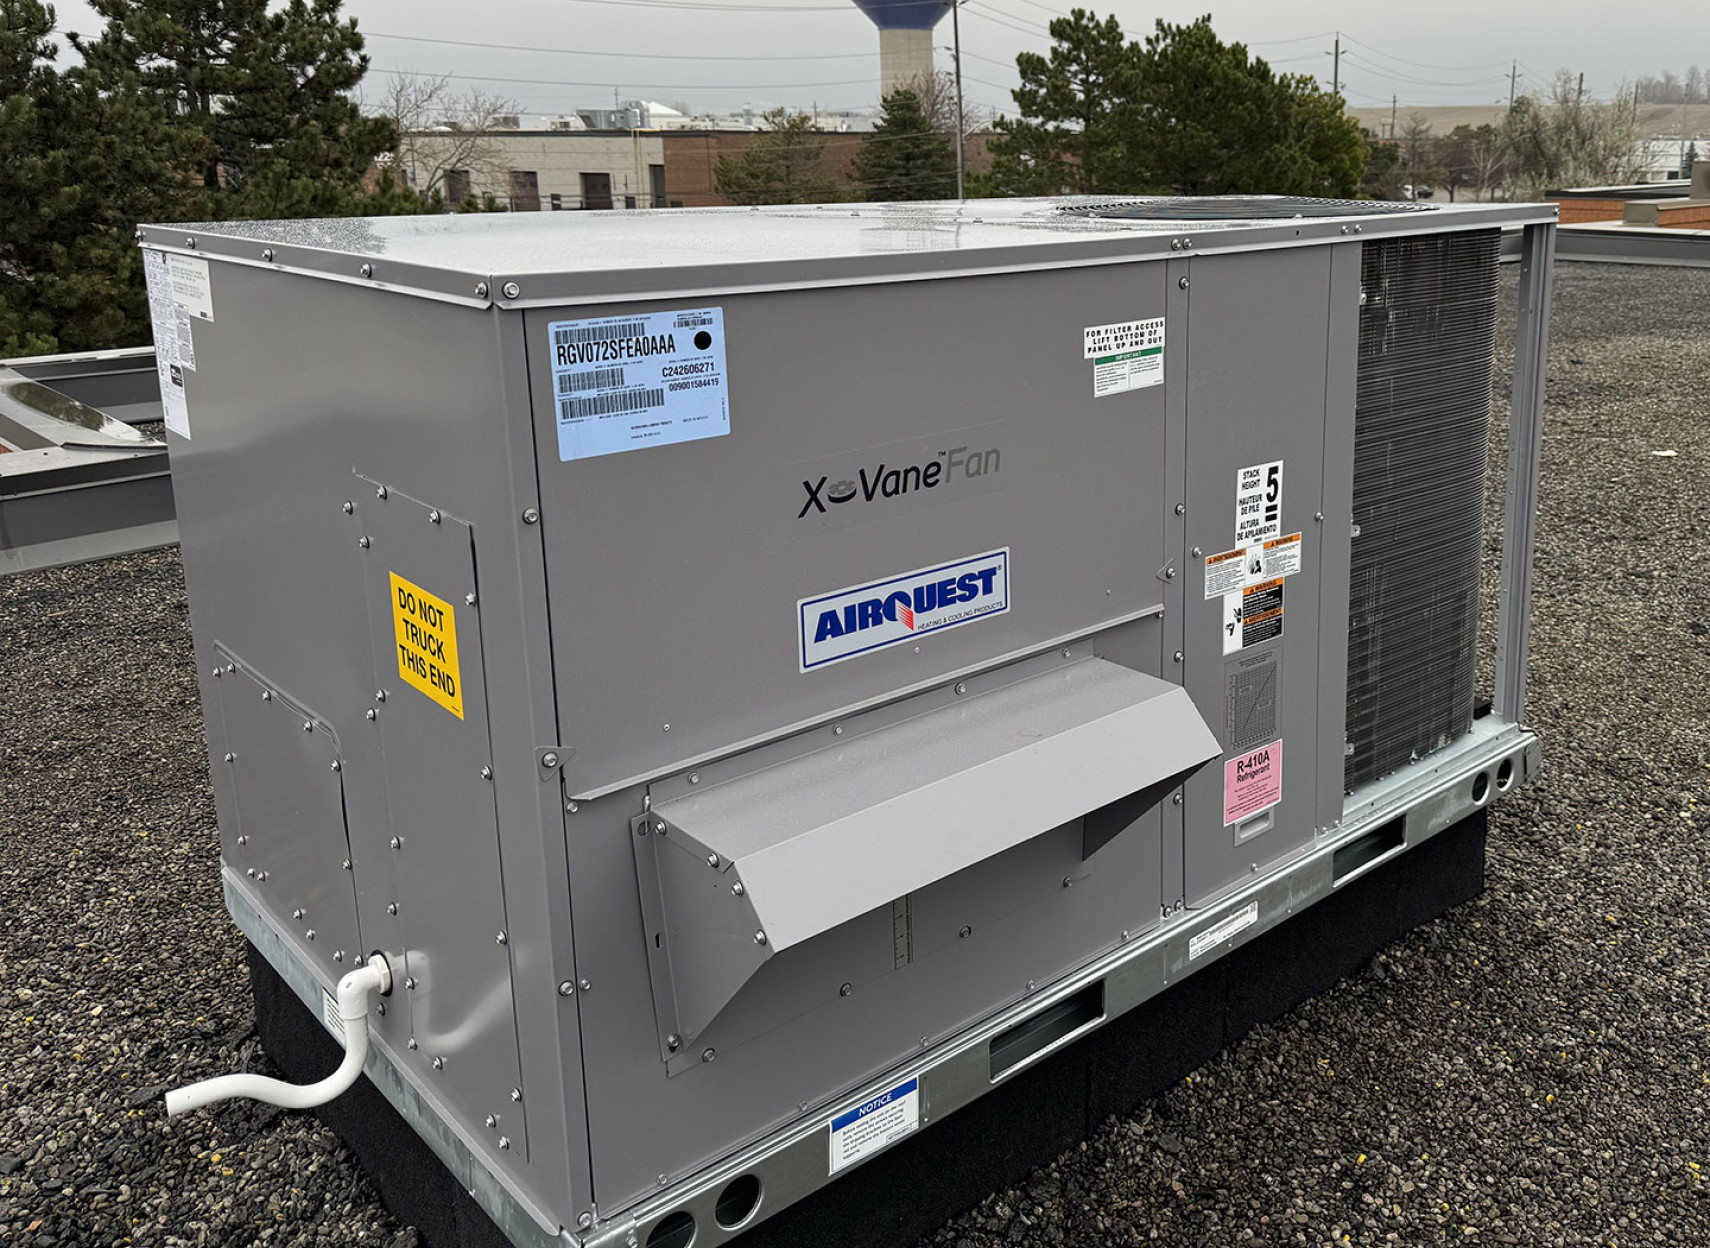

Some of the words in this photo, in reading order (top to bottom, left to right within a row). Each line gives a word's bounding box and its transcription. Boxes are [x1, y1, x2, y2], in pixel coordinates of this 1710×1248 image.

[1086, 330, 1101, 338] FOR
[1105, 326, 1132, 335] FILTER
[1135, 321, 1164, 330] ACCESS
[1093, 336, 1110, 345] LIFT
[1114, 331, 1145, 342] BOTTOM
[556, 334, 676, 366] RGV072SFEA0AAA
[1088, 344, 1112, 353] PANEL
[1129, 339, 1144, 347] AND
[1147, 336, 1162, 344] OUT
[662, 362, 715, 378] C242606271
[1243, 468, 1260, 480] STACK
[1242, 479, 1260, 490] HEIGHT
[1266, 465, 1279, 503] 5
[1241, 506, 1248, 515] DE
[1248, 503, 1259, 513] PILE
[1237, 532, 1243, 541] DE
[1245, 524, 1277, 538] APILAMIENTO
[1240, 518, 1259, 530] ALTURA
[398, 587, 416, 615] DO
[418, 598, 444, 632] NOT
[917, 619, 942, 630] HEATING
[948, 610, 973, 622] COOLING
[973, 601, 1003, 614] PRODUCTS
[402, 617, 446, 664] TRUCK
[399, 643, 427, 679] THIS
[429, 663, 455, 698] END
[1237, 750, 1270, 774] R-410A
[1237, 763, 1270, 784] Refrigerant
[859, 1093, 892, 1116] NOTICE
